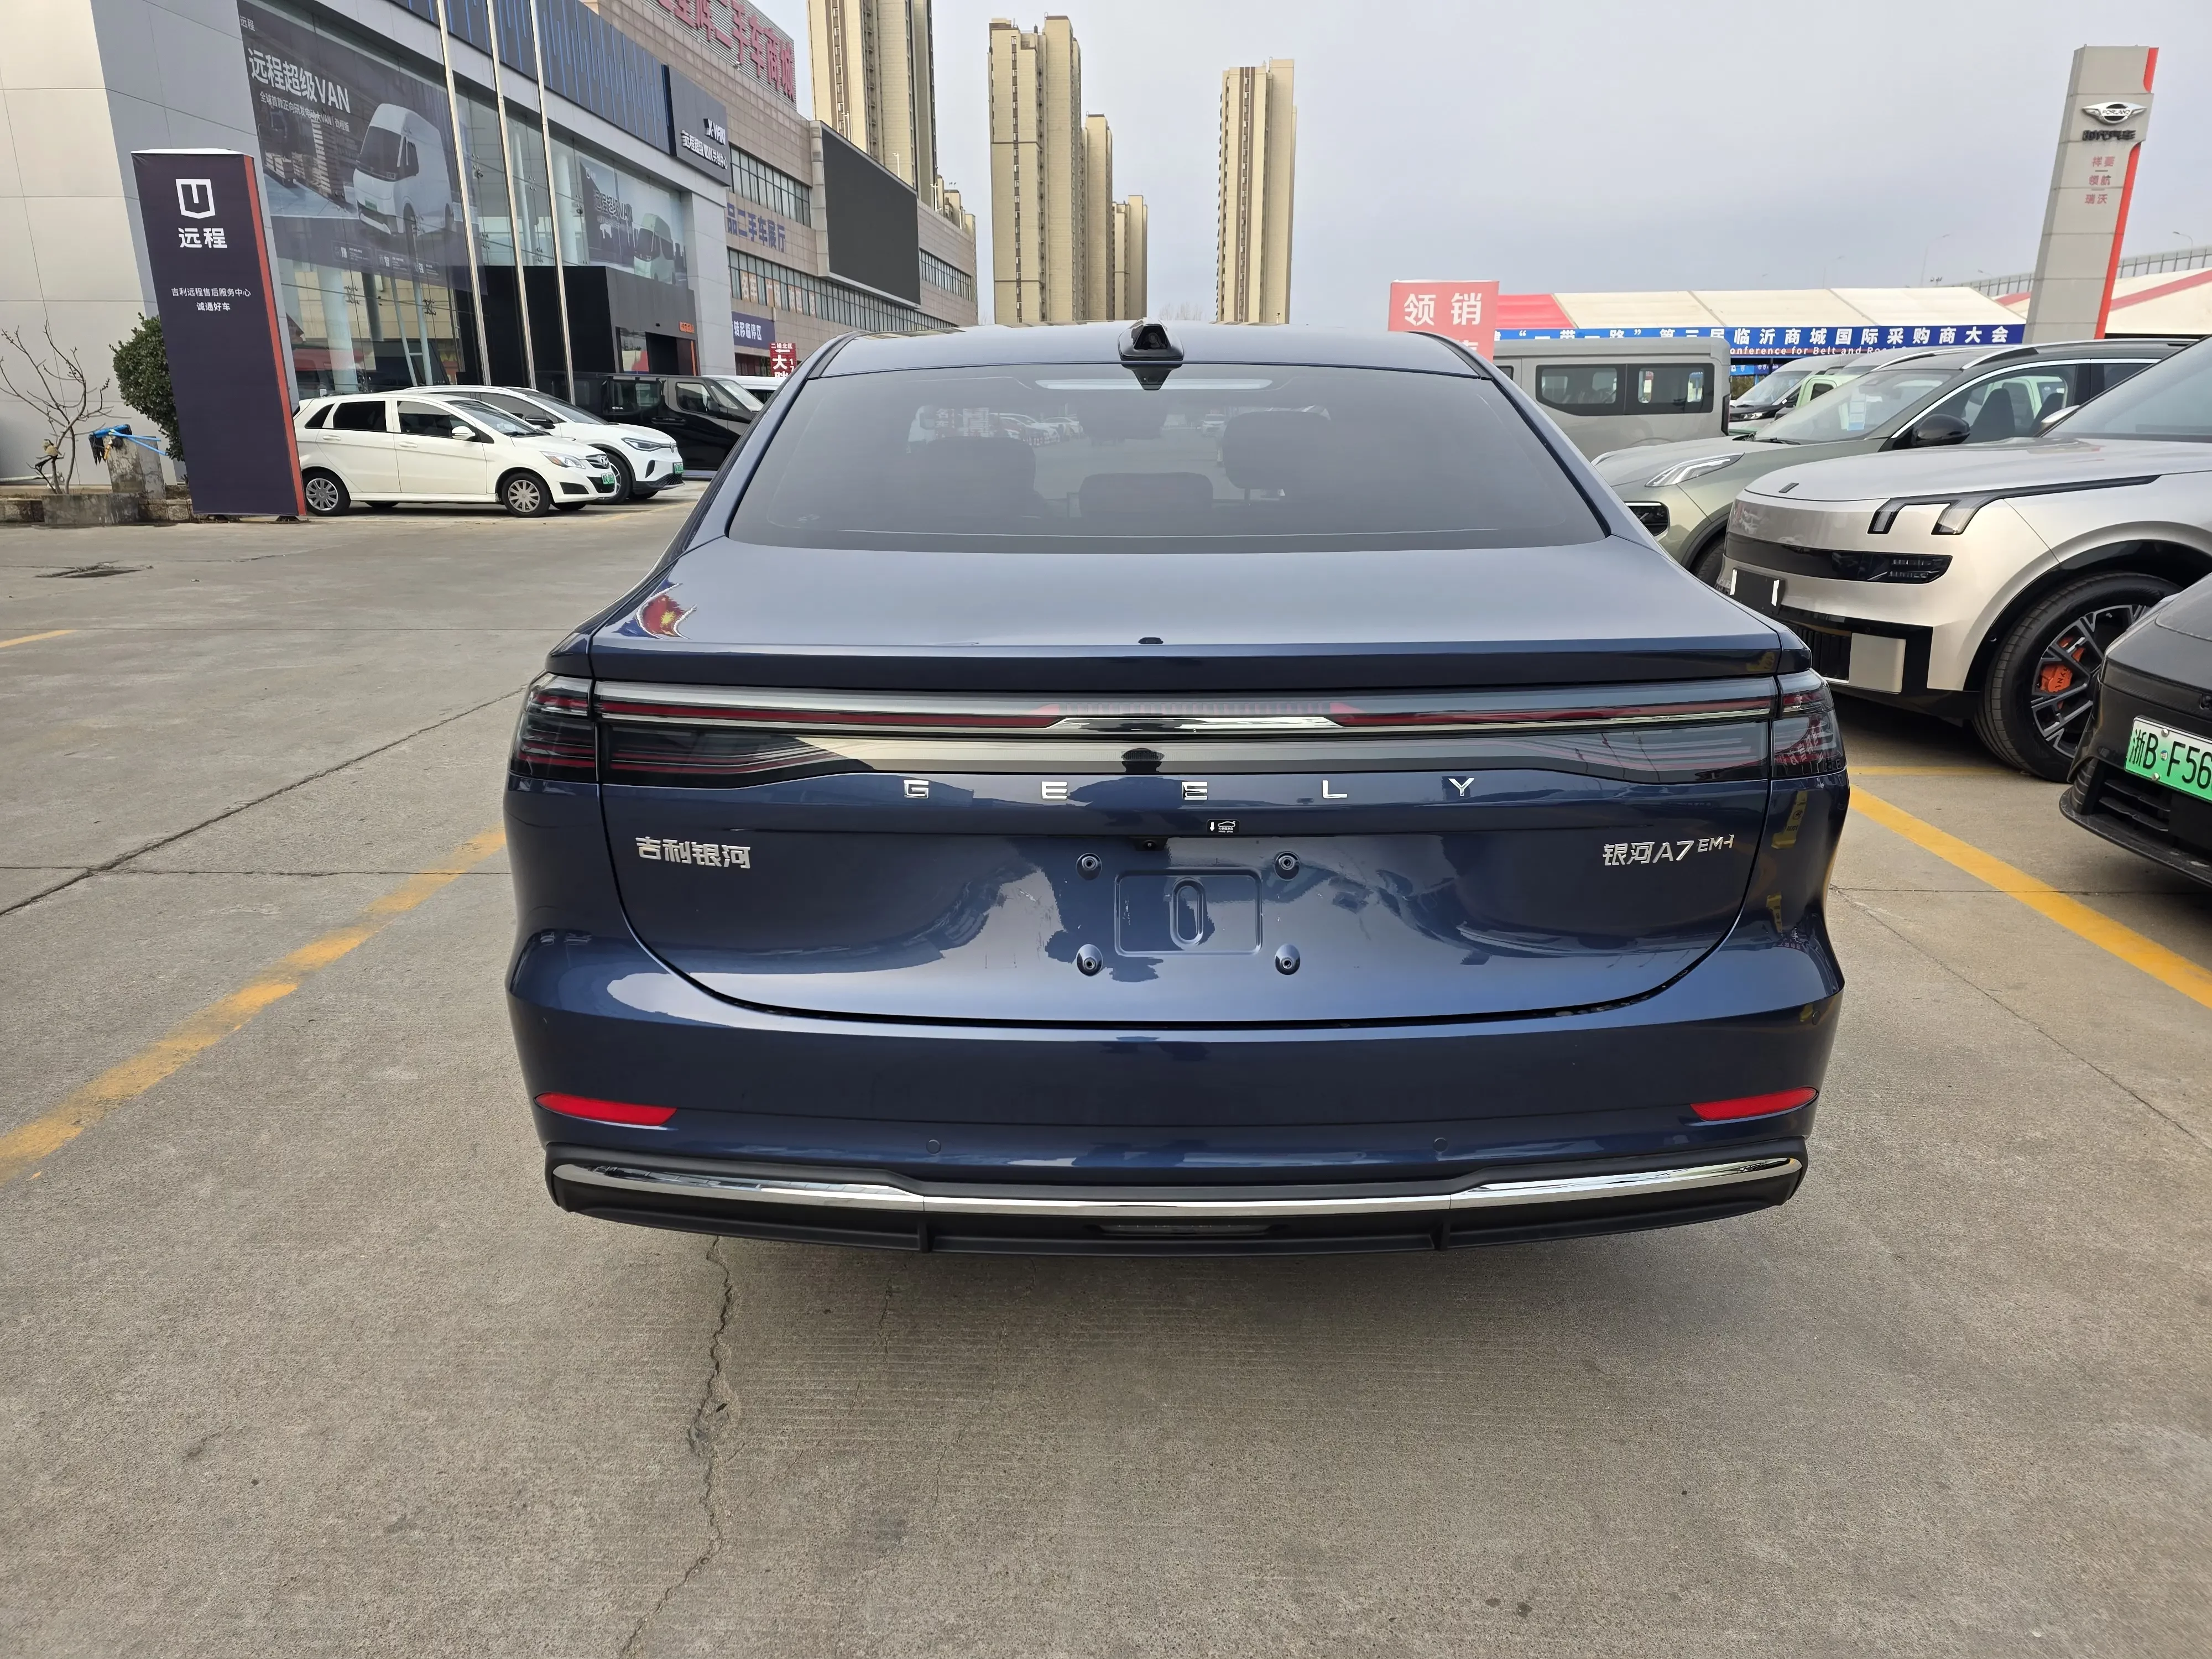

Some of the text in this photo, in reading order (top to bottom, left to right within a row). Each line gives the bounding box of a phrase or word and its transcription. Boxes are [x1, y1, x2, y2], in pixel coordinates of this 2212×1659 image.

[248, 48, 351, 113] 远程超级VAN
[178, 227, 227, 248] 远程
[171, 288, 251, 297] 吉利远程售后服务中心
[196, 302, 231, 311] 诚通好车
[732, 321, 762, 341] 转移临停区
[1730, 346, 1786, 354] onference
[1791, 346, 1808, 354] for
[1813, 346, 1835, 355] Belt
[635, 836, 750, 869] 吉利银河
[1603, 840, 1694, 866] 银河A7
